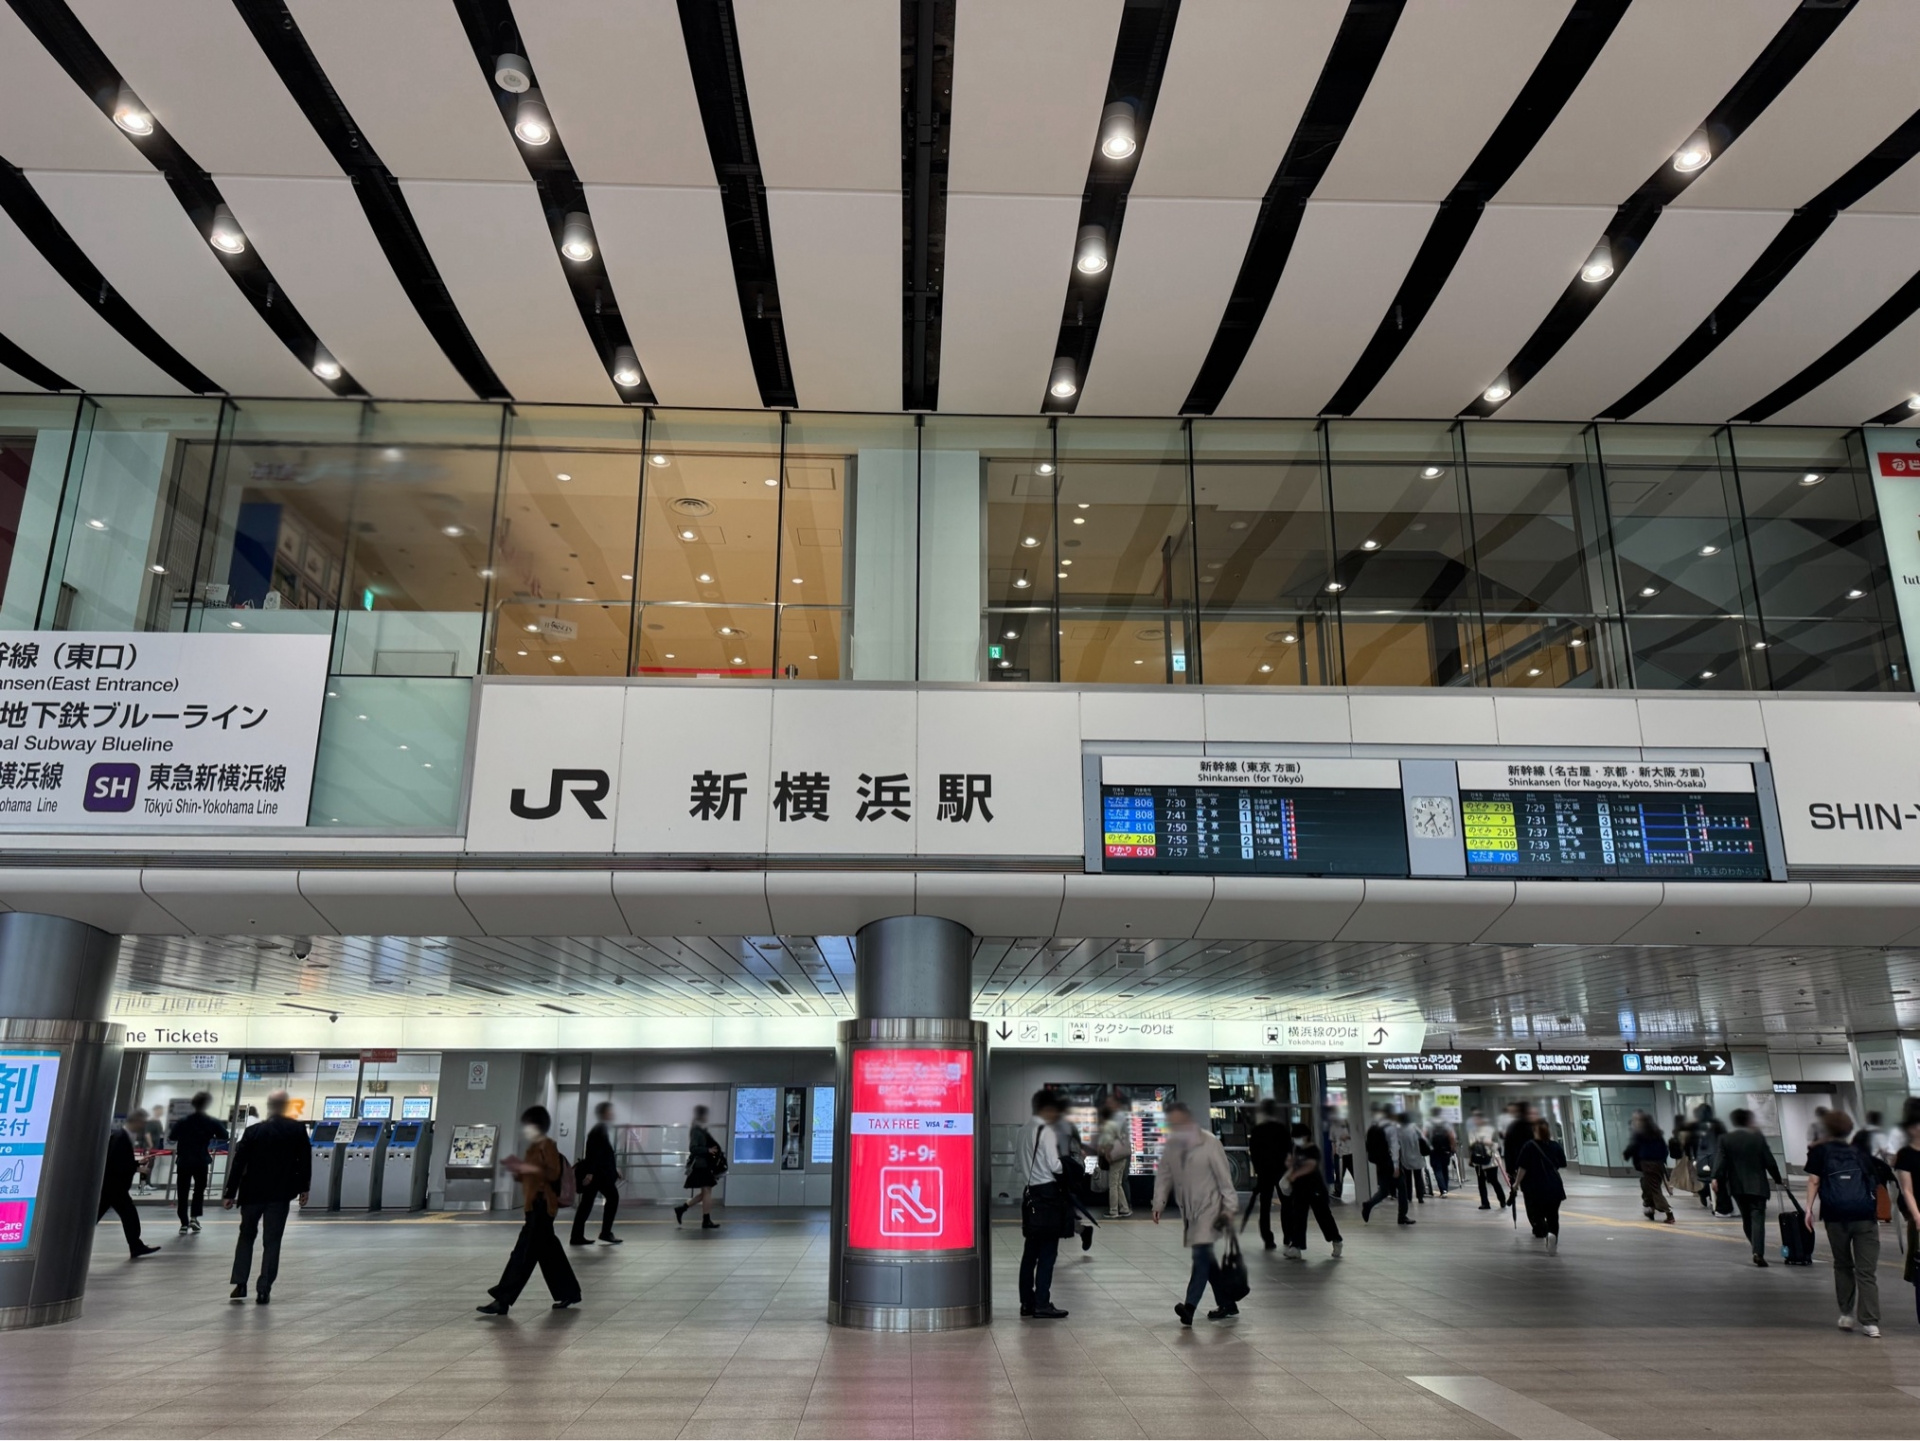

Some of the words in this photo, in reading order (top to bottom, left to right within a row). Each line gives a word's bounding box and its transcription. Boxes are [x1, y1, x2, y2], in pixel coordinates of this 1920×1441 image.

[0, 676, 91, 691] nsen(East
[96, 676, 179, 693] Entrance)
[0, 701, 269, 730] 地下鉄ブルーライン
[24, 735, 97, 755] Subway
[102, 736, 174, 752] Blueline
[147, 763, 287, 793] 東急新横浜線
[1198, 774, 1250, 783] Shinkansen
[1253, 774, 1270, 784] (for
[1509, 778, 1561, 787] Shinkansen
[1564, 778, 1581, 787] (for
[1583, 779, 1620, 789] Nagoya,
[93, 777, 131, 798] SH
[510, 769, 611, 820] JR
[689, 770, 994, 823] 新横浜駅
[37, 797, 58, 812] Line
[175, 799, 254, 814] Shin-Yokohama
[257, 799, 279, 815] Line
[1134, 798, 1153, 808] 806
[1165, 799, 1187, 808] 7:30
[1241, 799, 1249, 809] 2
[1494, 803, 1512, 812] 293
[1525, 804, 1546, 813] 7:29
[1600, 804, 1607, 813] 4
[1135, 810, 1153, 819] 808
[1166, 811, 1186, 820] 7:41
[1501, 815, 1507, 825] 9
[1526, 816, 1546, 825] 7:31
[1601, 816, 1609, 826] 3
[1808, 803, 1920, 831] SHIN-
[1135, 823, 1154, 832] 810
[1166, 823, 1188, 832] 7:50
[1496, 828, 1515, 837] 295
[1528, 828, 1548, 837] 7:37
[1603, 828, 1610, 838] 4
[1136, 835, 1154, 844] 268
[1167, 835, 1188, 844] 7:55
[1498, 840, 1516, 849] 109
[1529, 840, 1550, 850] 7:39
[1604, 841, 1612, 851] 3
[1136, 847, 1155, 856] 630
[1168, 847, 1189, 857] 7:57
[1499, 852, 1518, 862] 705
[1530, 852, 1552, 862] 7:45
[1605, 853, 1613, 863] 3
[1094, 1023, 1174, 1035] タクシーのりば
[1288, 1026, 1360, 1038] 横浜線のりば
[154, 1028, 219, 1043] Tickets
[1288, 1039, 1326, 1047] Yokohama
[1328, 1039, 1345, 1047] Line
[1536, 1055, 1590, 1064] 横浜線のりば
[1644, 1055, 1699, 1064] 新幹線のりば
[1537, 1064, 1571, 1072] Yokohama
[868, 1118, 889, 1130] TAX
[892, 1118, 920, 1130] FREE
